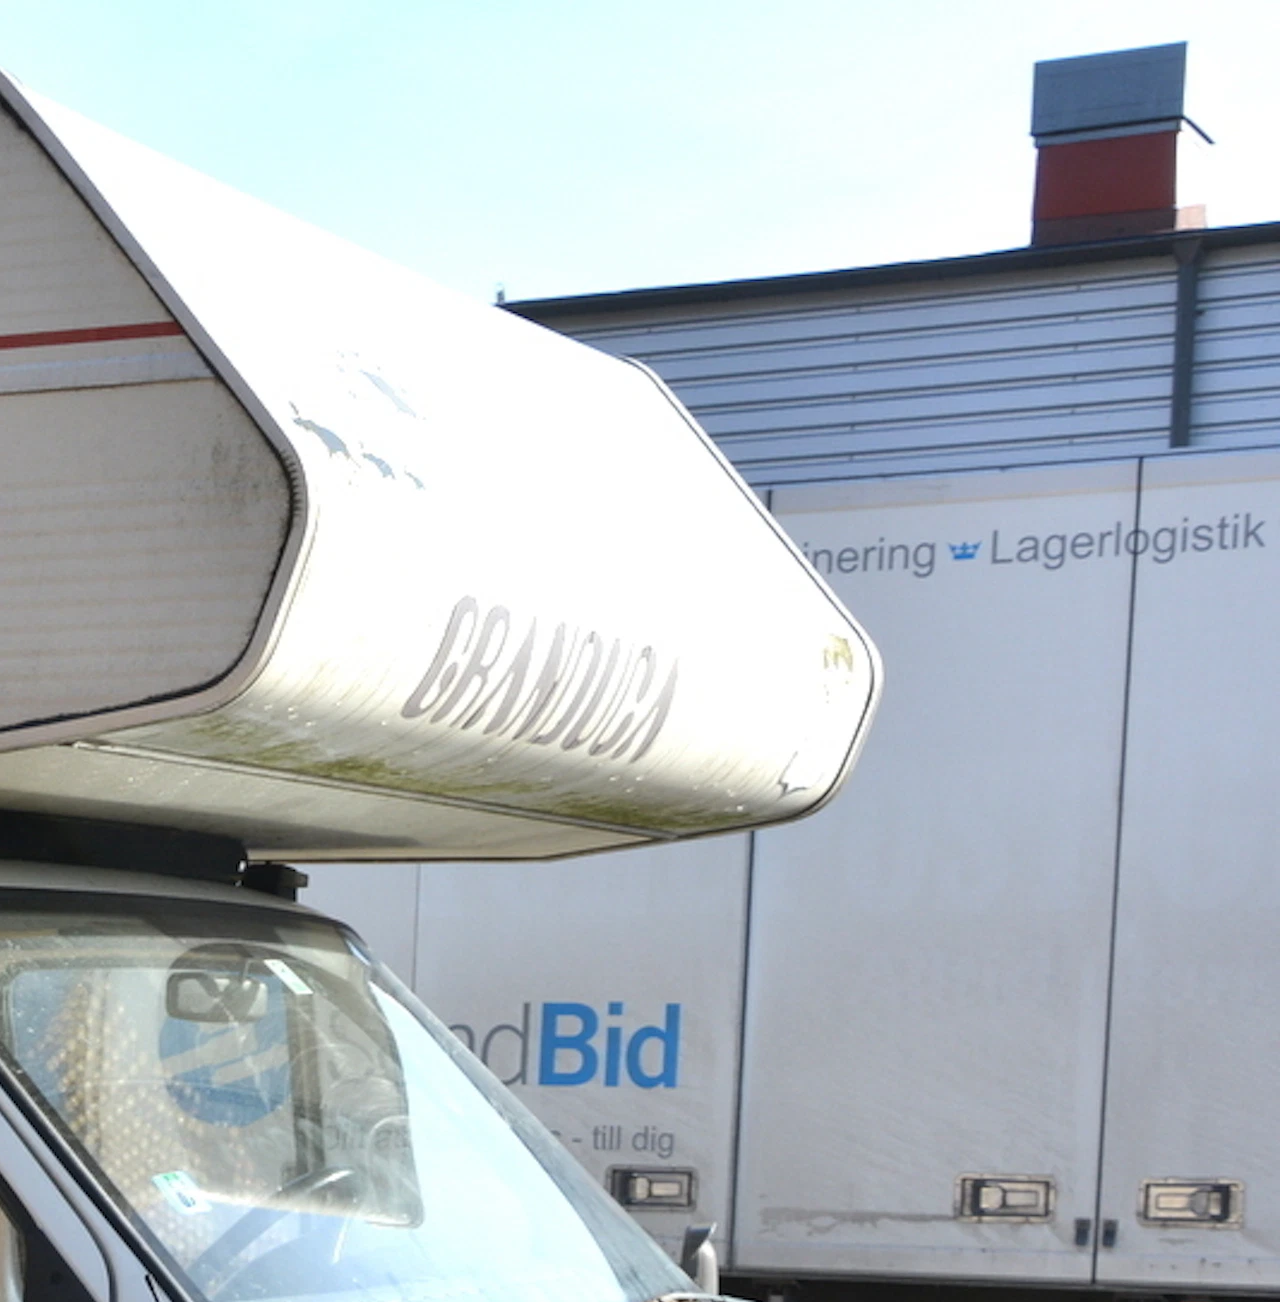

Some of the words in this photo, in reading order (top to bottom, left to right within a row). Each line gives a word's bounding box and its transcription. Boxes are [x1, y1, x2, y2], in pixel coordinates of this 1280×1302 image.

[991, 512, 1266, 570] Lagerlogistik
[592, 1125, 622, 1151] till
[632, 1125, 675, 1160] dig
